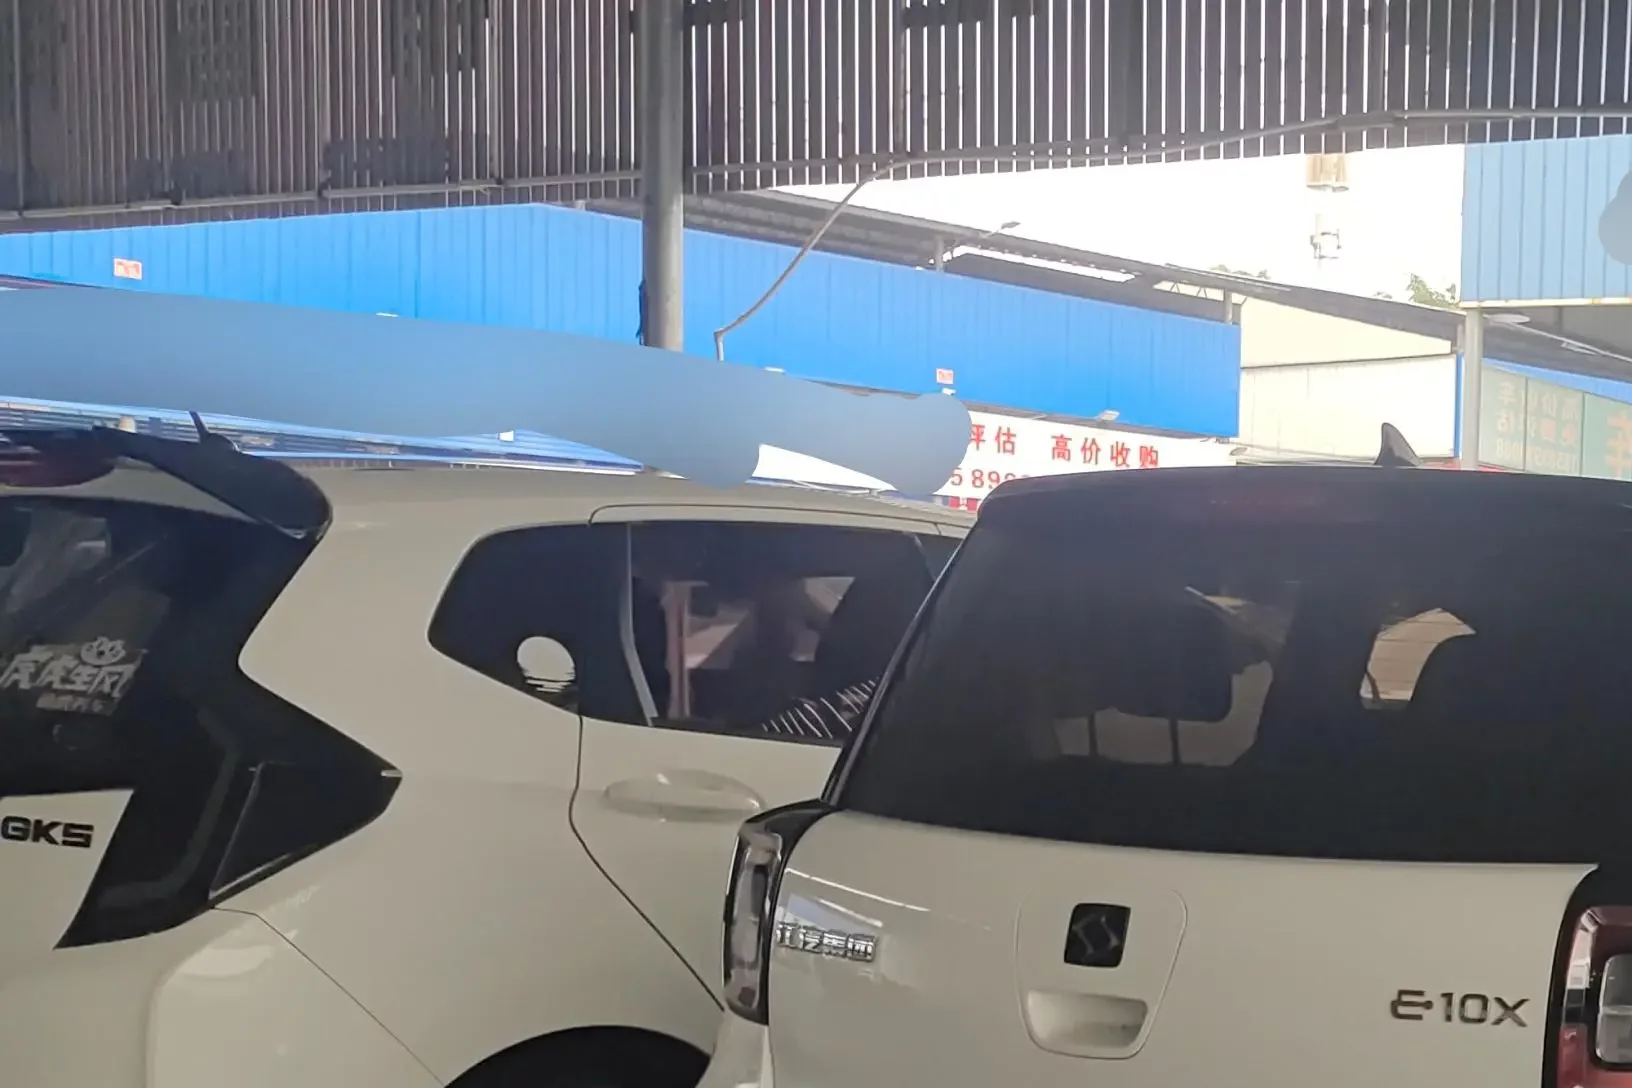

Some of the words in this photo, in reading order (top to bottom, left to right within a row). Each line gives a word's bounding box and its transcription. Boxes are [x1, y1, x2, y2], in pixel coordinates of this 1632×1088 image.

[1051, 434, 1160, 468] 高价收购
[951, 466, 1031, 489] 589
